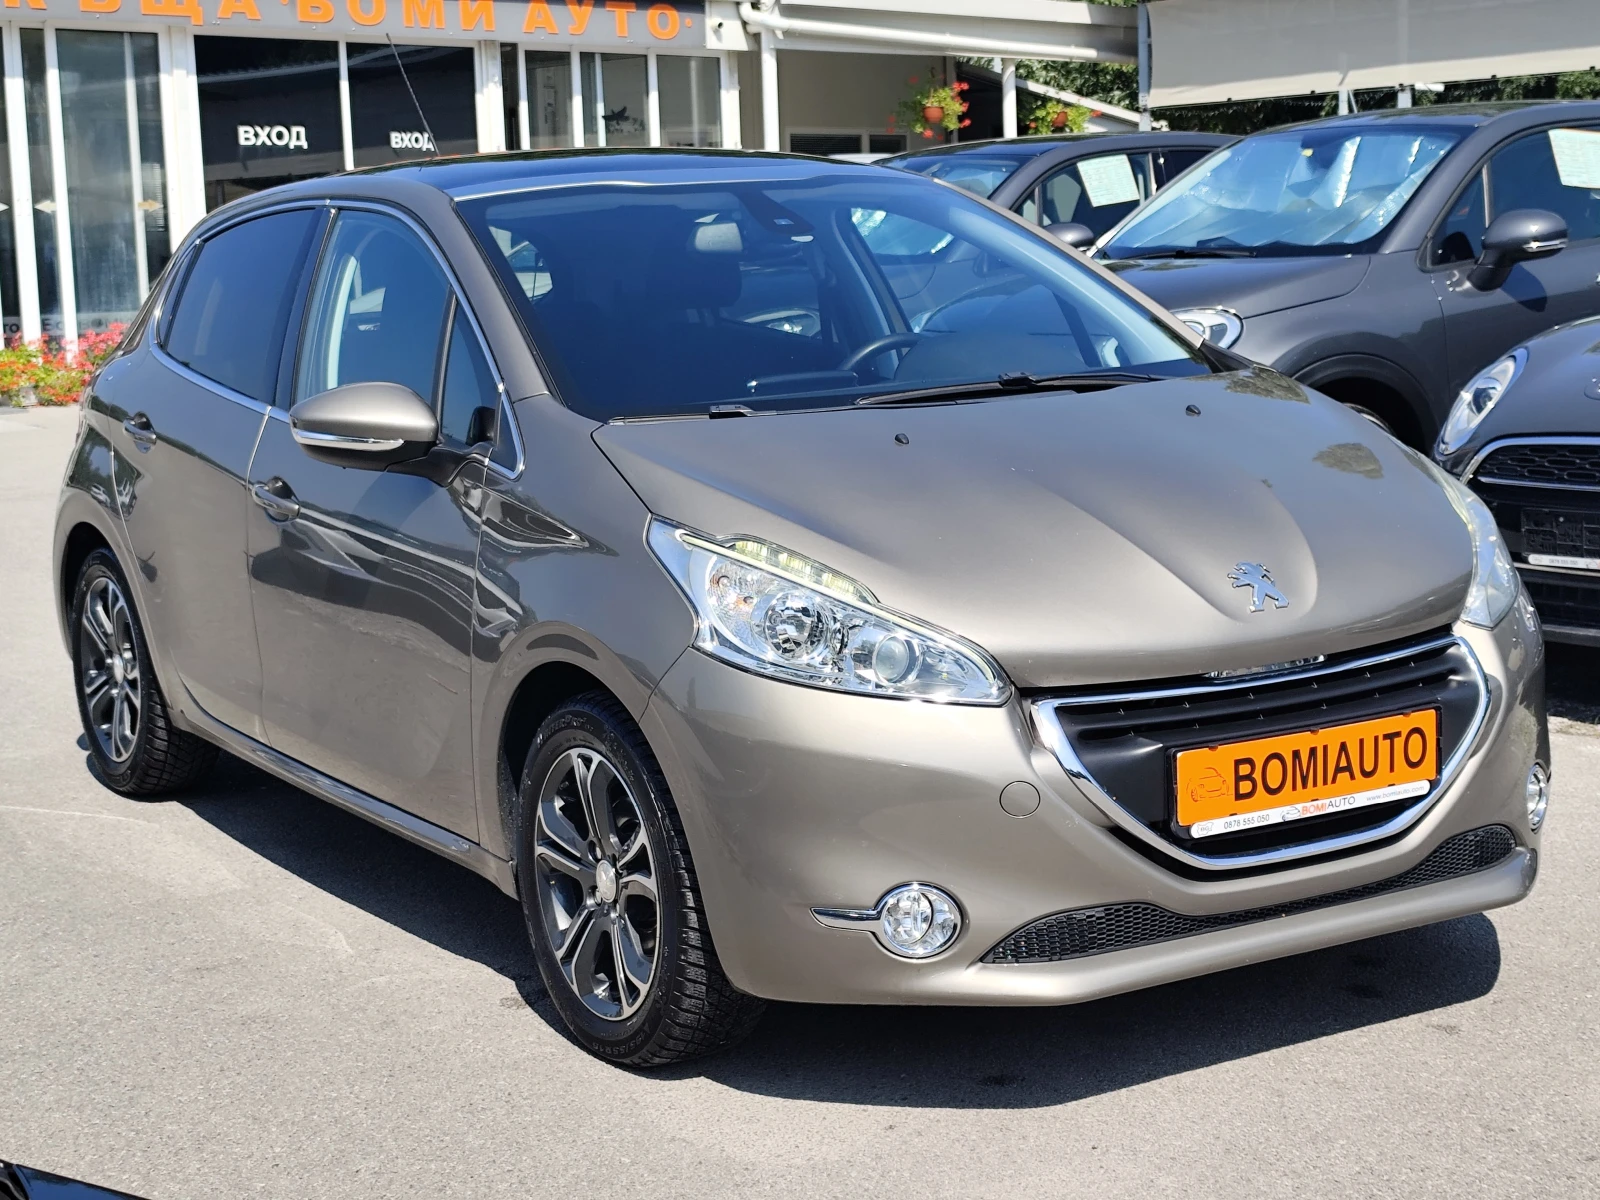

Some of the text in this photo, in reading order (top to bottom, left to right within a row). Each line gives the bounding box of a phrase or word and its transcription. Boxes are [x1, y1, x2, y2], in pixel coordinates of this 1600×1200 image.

[237, 125, 308, 149] ВХОД
[1233, 726, 1428, 801] BOMIAUTO
[1223, 819, 1241, 830] 0878
[1243, 816, 1256, 827] 555
[1257, 813, 1270, 824] 050
[1301, 796, 1356, 816] BOMIAUTO
